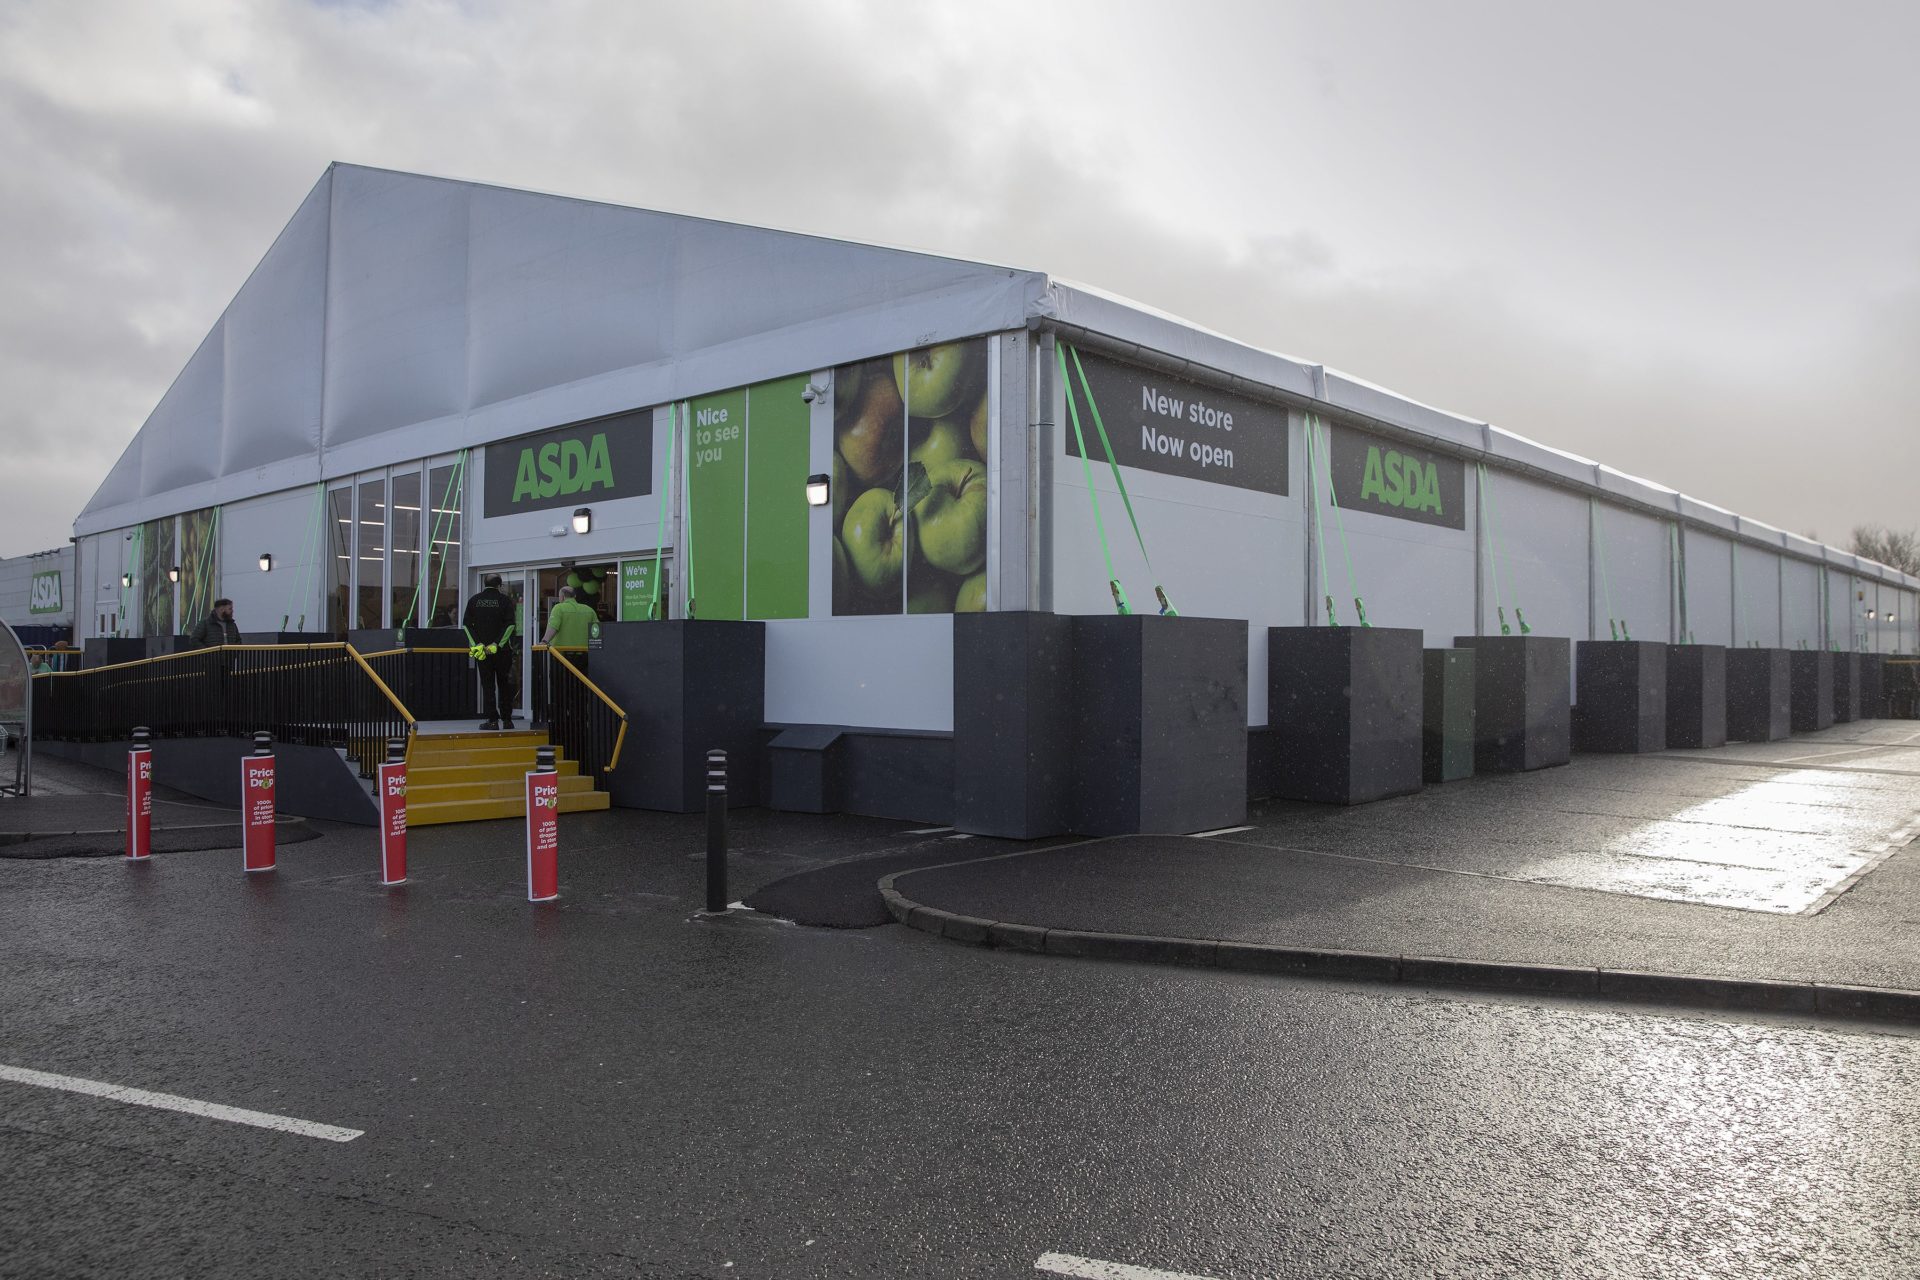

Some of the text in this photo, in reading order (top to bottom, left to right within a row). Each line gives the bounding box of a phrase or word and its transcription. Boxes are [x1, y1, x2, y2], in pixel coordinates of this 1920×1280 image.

[697, 408, 728, 427] Nice
[1142, 386, 1233, 431] New store
[696, 425, 739, 445] to see
[1142, 426, 1233, 468] Now open
[696, 448, 721, 467] you
[512, 433, 614, 502] ASDA
[1361, 446, 1443, 515] ASDA
[626, 566, 647, 576] We're
[31, 575, 60, 610] ASDA
[626, 580, 644, 590] open
[250, 768, 274, 778] Price
[388, 775, 406, 786] Pric
[250, 778, 273, 789] Drop
[388, 786, 406, 797] Dro
